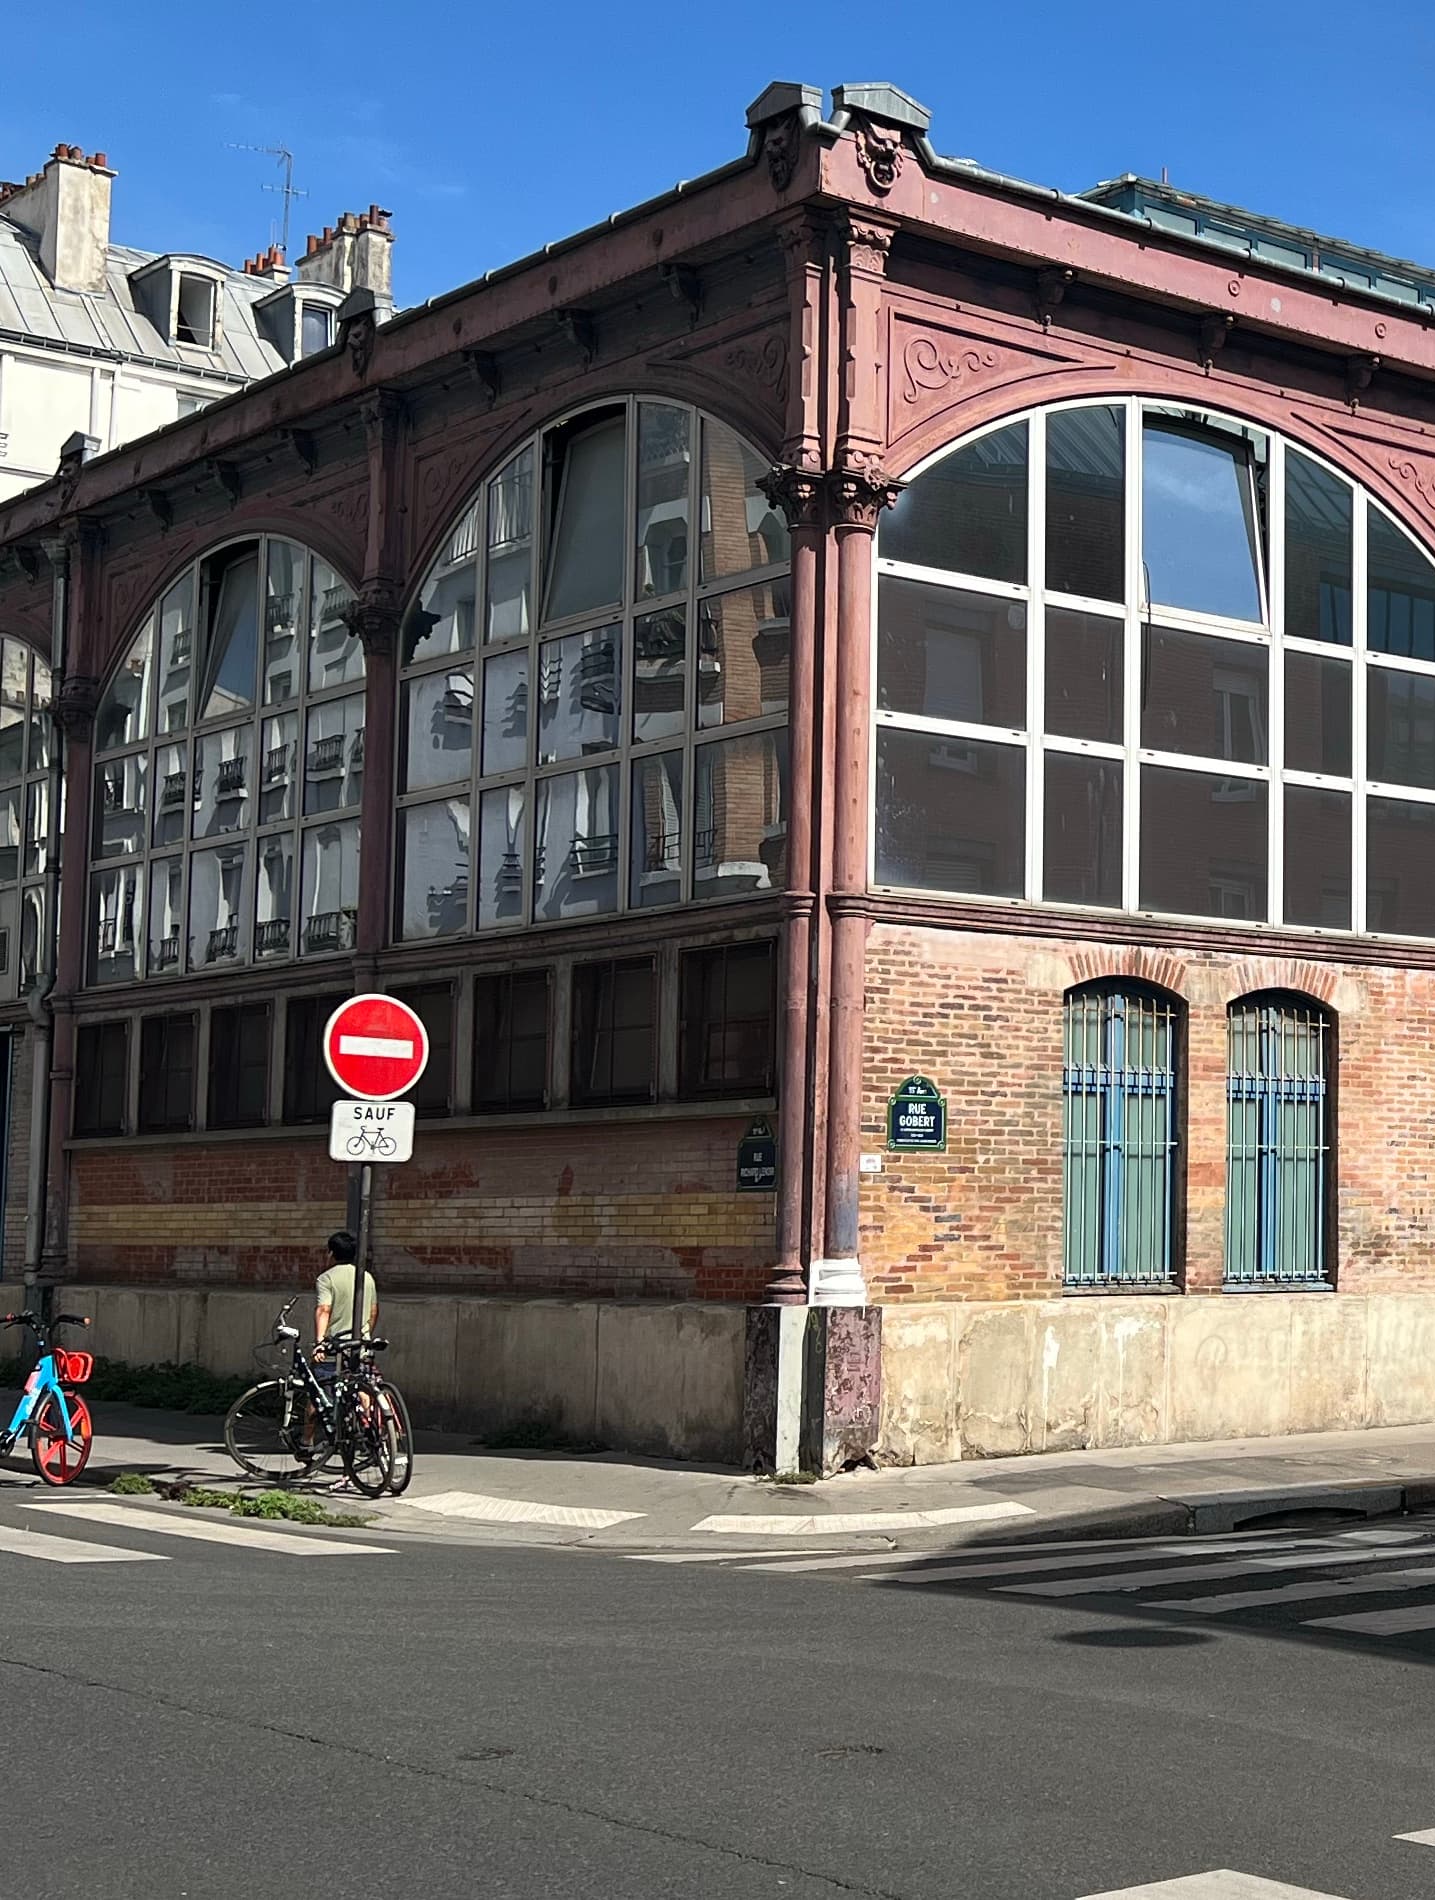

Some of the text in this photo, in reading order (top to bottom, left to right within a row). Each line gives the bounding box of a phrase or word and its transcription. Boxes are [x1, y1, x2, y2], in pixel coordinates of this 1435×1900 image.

[353, 1106, 396, 1120] SAUF
[908, 1103, 927, 1115] RUE
[899, 1114, 936, 1128] GOBERT
